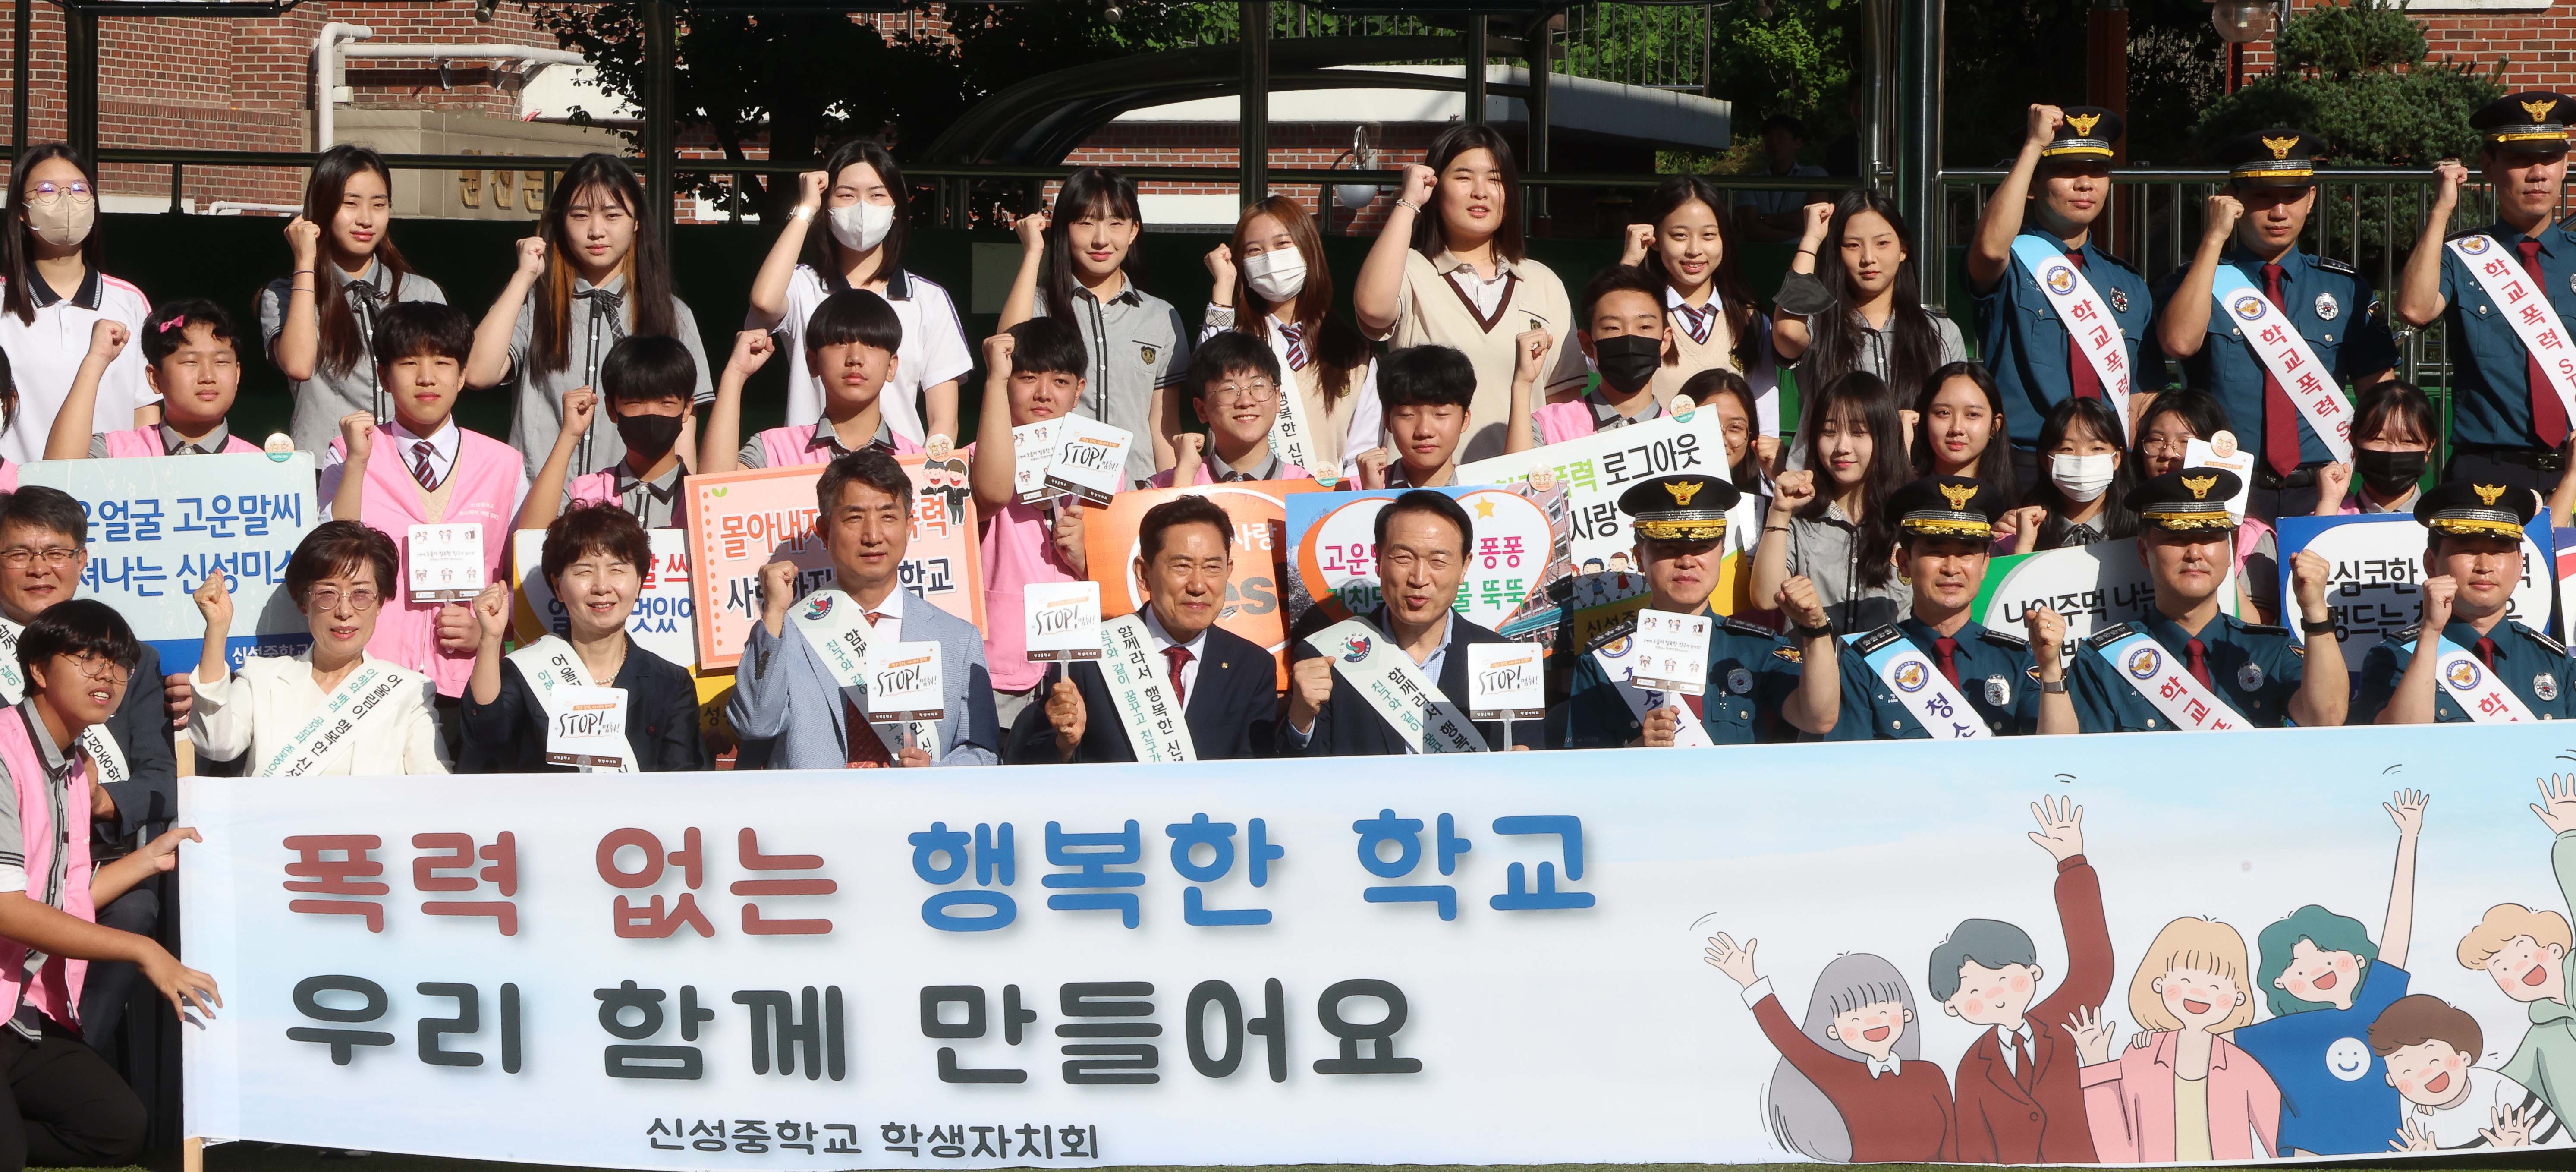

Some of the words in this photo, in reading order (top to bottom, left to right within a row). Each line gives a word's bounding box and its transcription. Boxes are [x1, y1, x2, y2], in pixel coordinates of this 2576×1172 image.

[2483, 258, 2563, 349] 학교폭력
[2071, 298, 2129, 396] 학교폭력
[2260, 324, 2340, 417] 학교폭력
[1061, 442, 1107, 469] STOP!
[1603, 433, 1702, 486] 로그아웃
[173, 493, 301, 538] 고운말씨
[1570, 501, 1619, 542] 사랑
[1323, 543, 1382, 576] 고운
[1479, 536, 1525, 570] 퐁퐁
[2326, 557, 2418, 597] 심코한
[1326, 586, 1384, 617] 거친
[1481, 578, 1526, 611] 뚝뚝
[1036, 605, 1078, 636] STOP!
[0, 624, 19, 662] 함께
[825, 639, 854, 671] 친구와
[844, 628, 867, 658] 함께
[349, 668, 378, 693] 이해와
[552, 654, 582, 686] 어울
[877, 665, 919, 697] STOP!
[1479, 665, 1521, 695] STOP!
[328, 693, 350, 713] 배려
[352, 674, 404, 720] 어울림이
[1113, 662, 1130, 684] 같이
[1125, 690, 1147, 725] 꿈꾸고
[1140, 729, 1162, 762] 친구가
[1117, 625, 1153, 680] 함께라서
[1144, 685, 1174, 735] 행복한
[1167, 740, 1184, 762] 신
[1387, 666, 1443, 721] 함께라서
[1440, 720, 1477, 752] 행복
[294, 715, 324, 744] 공감과
[560, 711, 604, 738] STOP!
[1371, 680, 1402, 711] 친구와
[1401, 710, 1425, 731] 같이
[1423, 732, 1447, 752] 꿈꾸
[311, 718, 353, 756] 행복한
[283, 830, 519, 937] 폭력
[596, 826, 838, 939] 없는
[908, 812, 1284, 932] 행복한
[1352, 808, 1596, 921] 학교
[286, 974, 521, 1074] 우리
[593, 980, 846, 1081] 함께
[920, 977, 1423, 1085] 만들어요
[647, 1118, 862, 1155] 신성중학교
[880, 1121, 1098, 1160] 학생자치회
